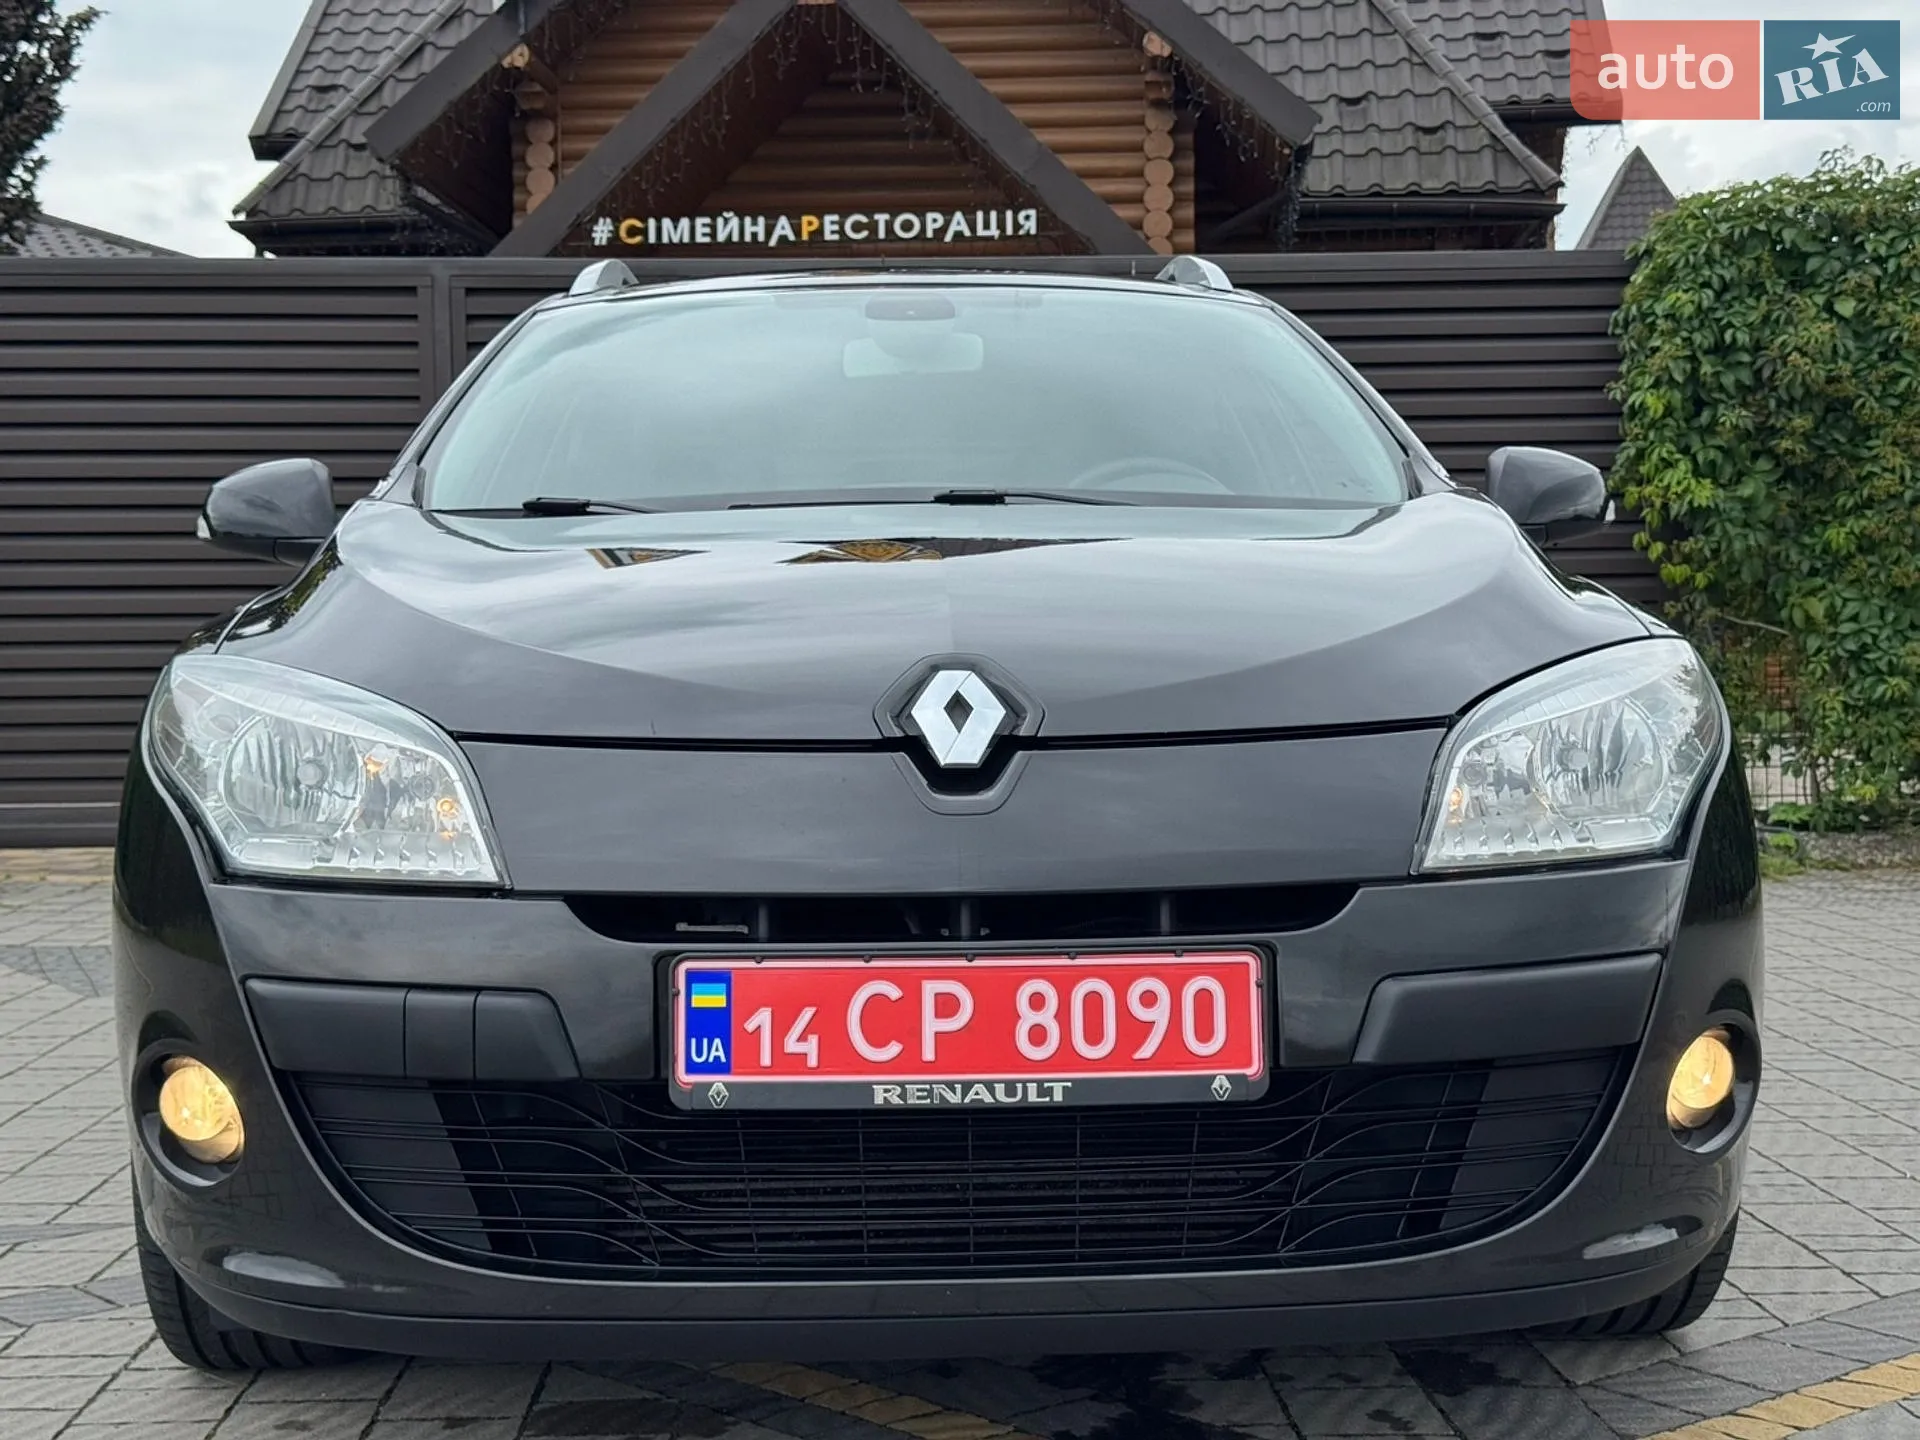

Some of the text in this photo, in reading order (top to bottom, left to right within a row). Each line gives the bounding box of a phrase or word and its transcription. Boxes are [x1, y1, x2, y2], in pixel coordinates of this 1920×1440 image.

[591, 208, 1038, 247] #СІМЕЙНАРЕСТОРАЦІЯ
[690, 1037, 727, 1064] UA
[743, 1006, 819, 1068] 14
[1014, 975, 1229, 1061] 8090
[871, 1082, 1073, 1106] RENAULT
